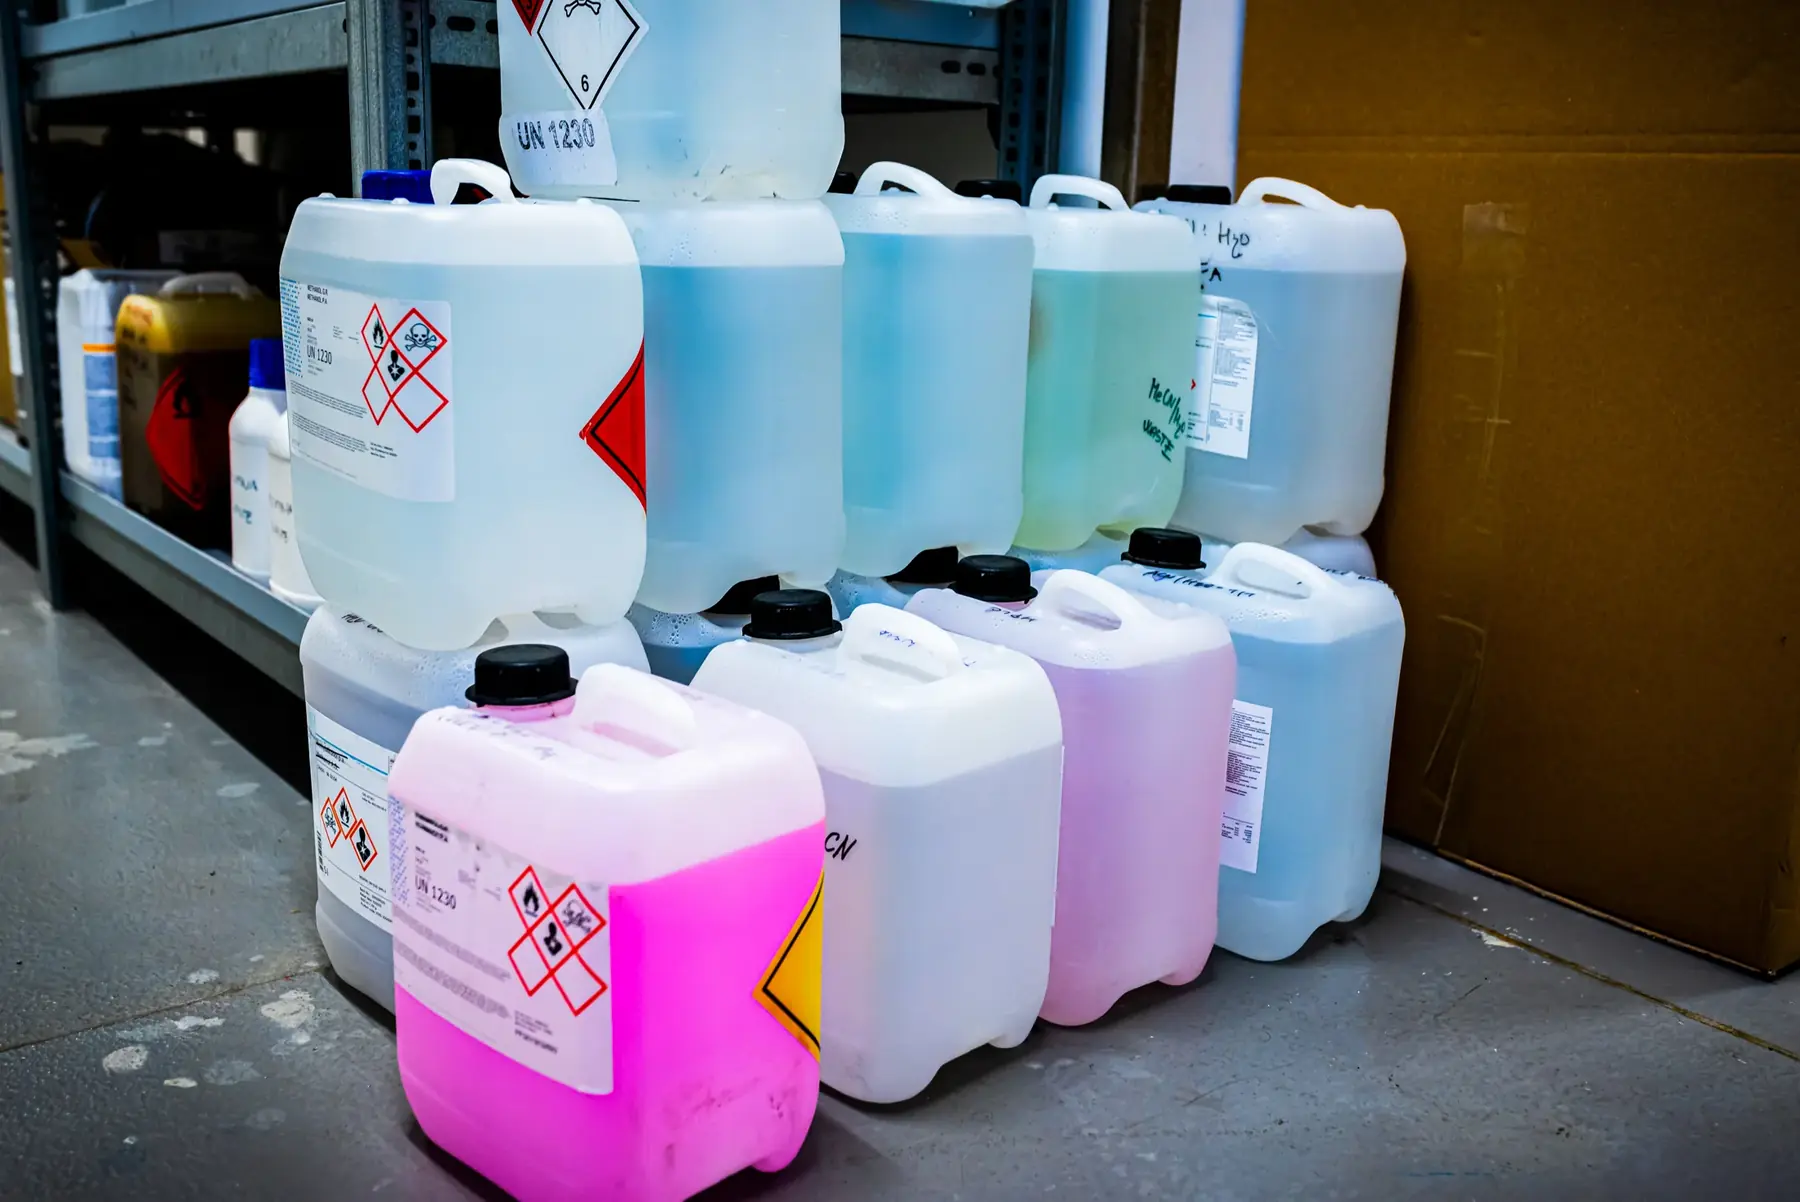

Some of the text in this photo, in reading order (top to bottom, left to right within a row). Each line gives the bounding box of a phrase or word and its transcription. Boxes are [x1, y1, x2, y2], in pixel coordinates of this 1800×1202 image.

[581, 74, 590, 92] 6
[516, 117, 596, 150] UN 1230
[306, 344, 333, 365] UN 1230
[414, 875, 428, 895] UN
[431, 885, 457, 910] 1230
